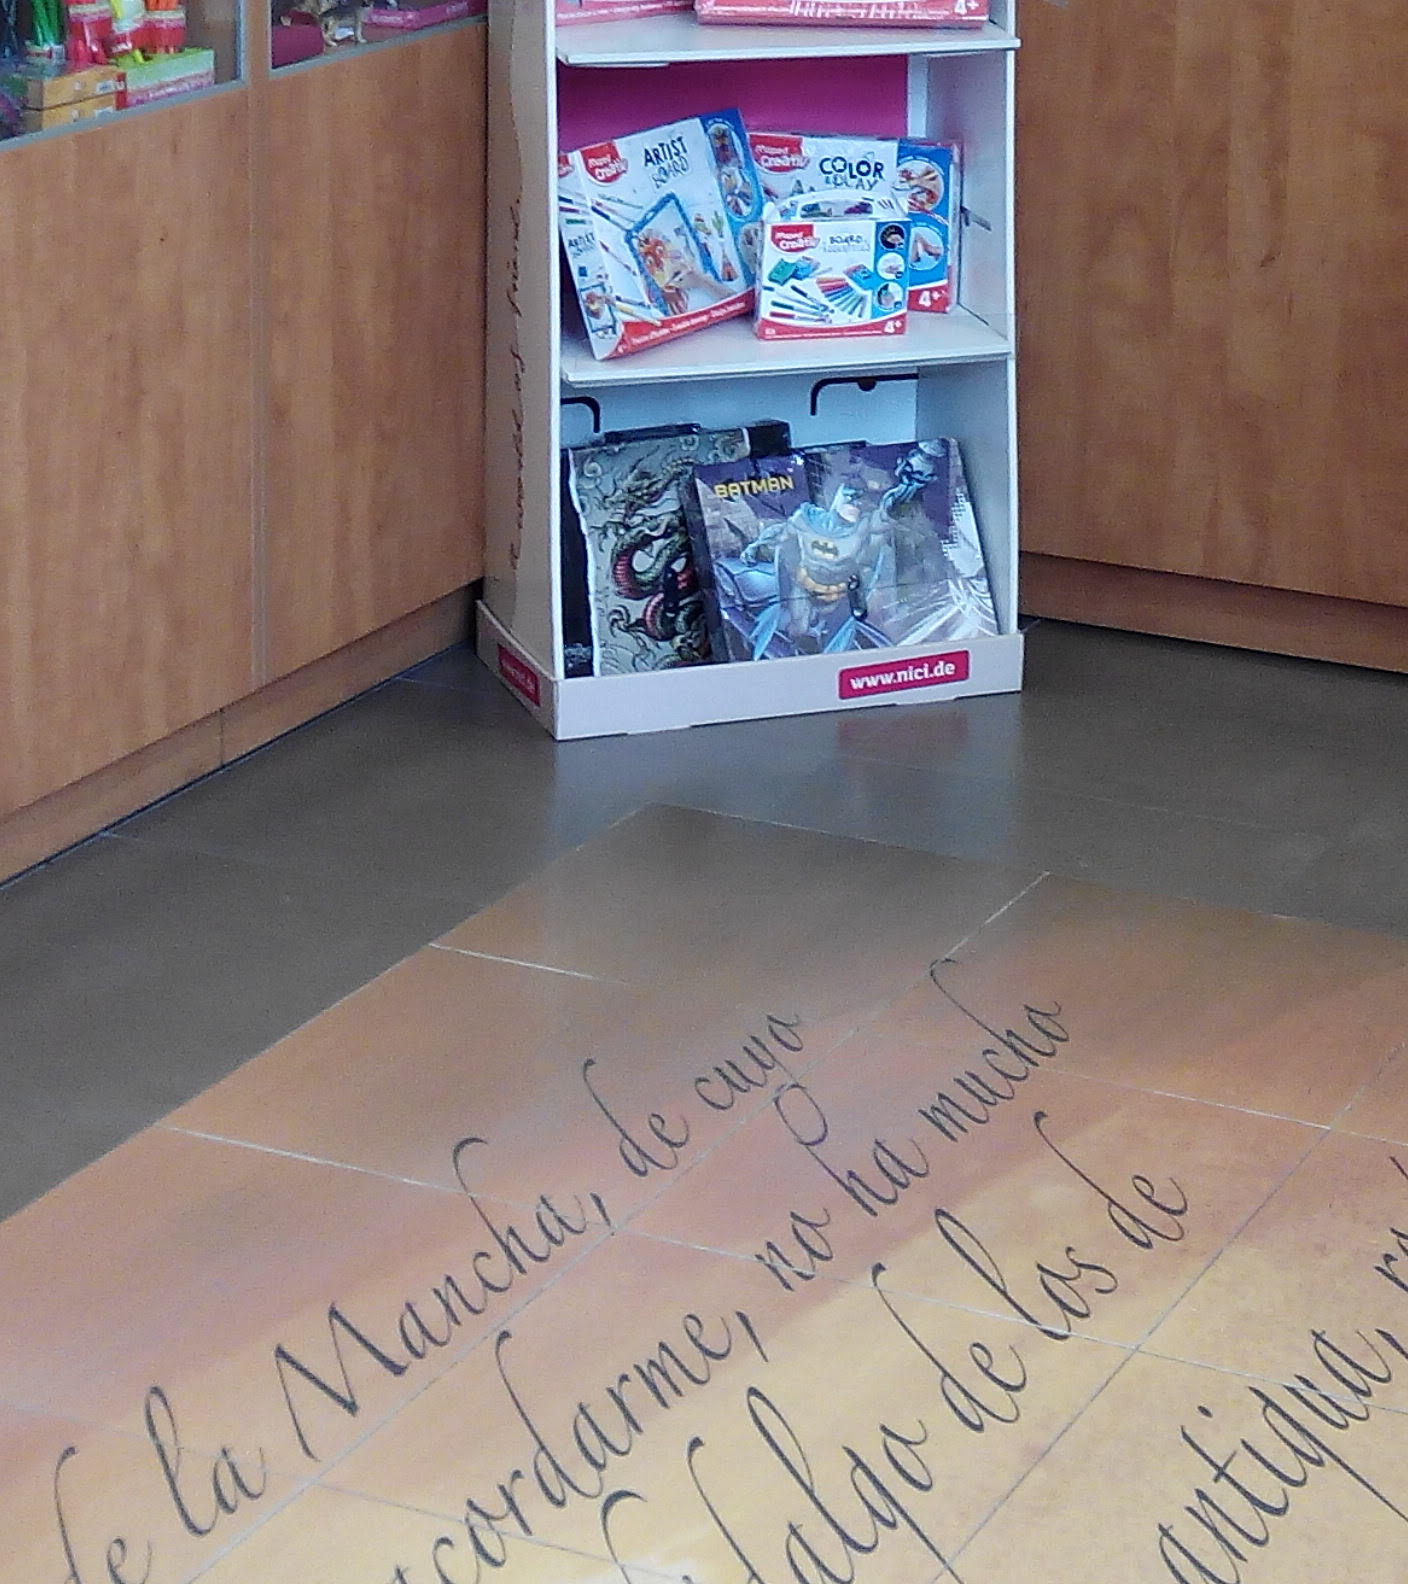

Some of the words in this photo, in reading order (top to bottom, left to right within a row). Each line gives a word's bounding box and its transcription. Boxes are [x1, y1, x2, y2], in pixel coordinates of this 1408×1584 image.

[643, 135, 689, 168] ARTIST
[818, 155, 885, 181] COLOR
[882, 318, 903, 334] 4+
[918, 290, 942, 308] 4+
[713, 475, 795, 499] BATMAN
[849, 660, 957, 691] www.nici.de
[917, 957, 1071, 1142] mucho
[773, 1082, 931, 1217] ha
[1032, 1109, 1190, 1250] de
[144, 1384, 268, 1537] la
[274, 1136, 615, 1463] Mancha,
[581, 1057, 690, 1179] de
[693, 1012, 806, 1114] cuyo
[754, 1207, 836, 1292] no
[933, 1207, 1118, 1342] los
[870, 1261, 1028, 1434] de
[395, 1312, 770, 1584] cordarme,
